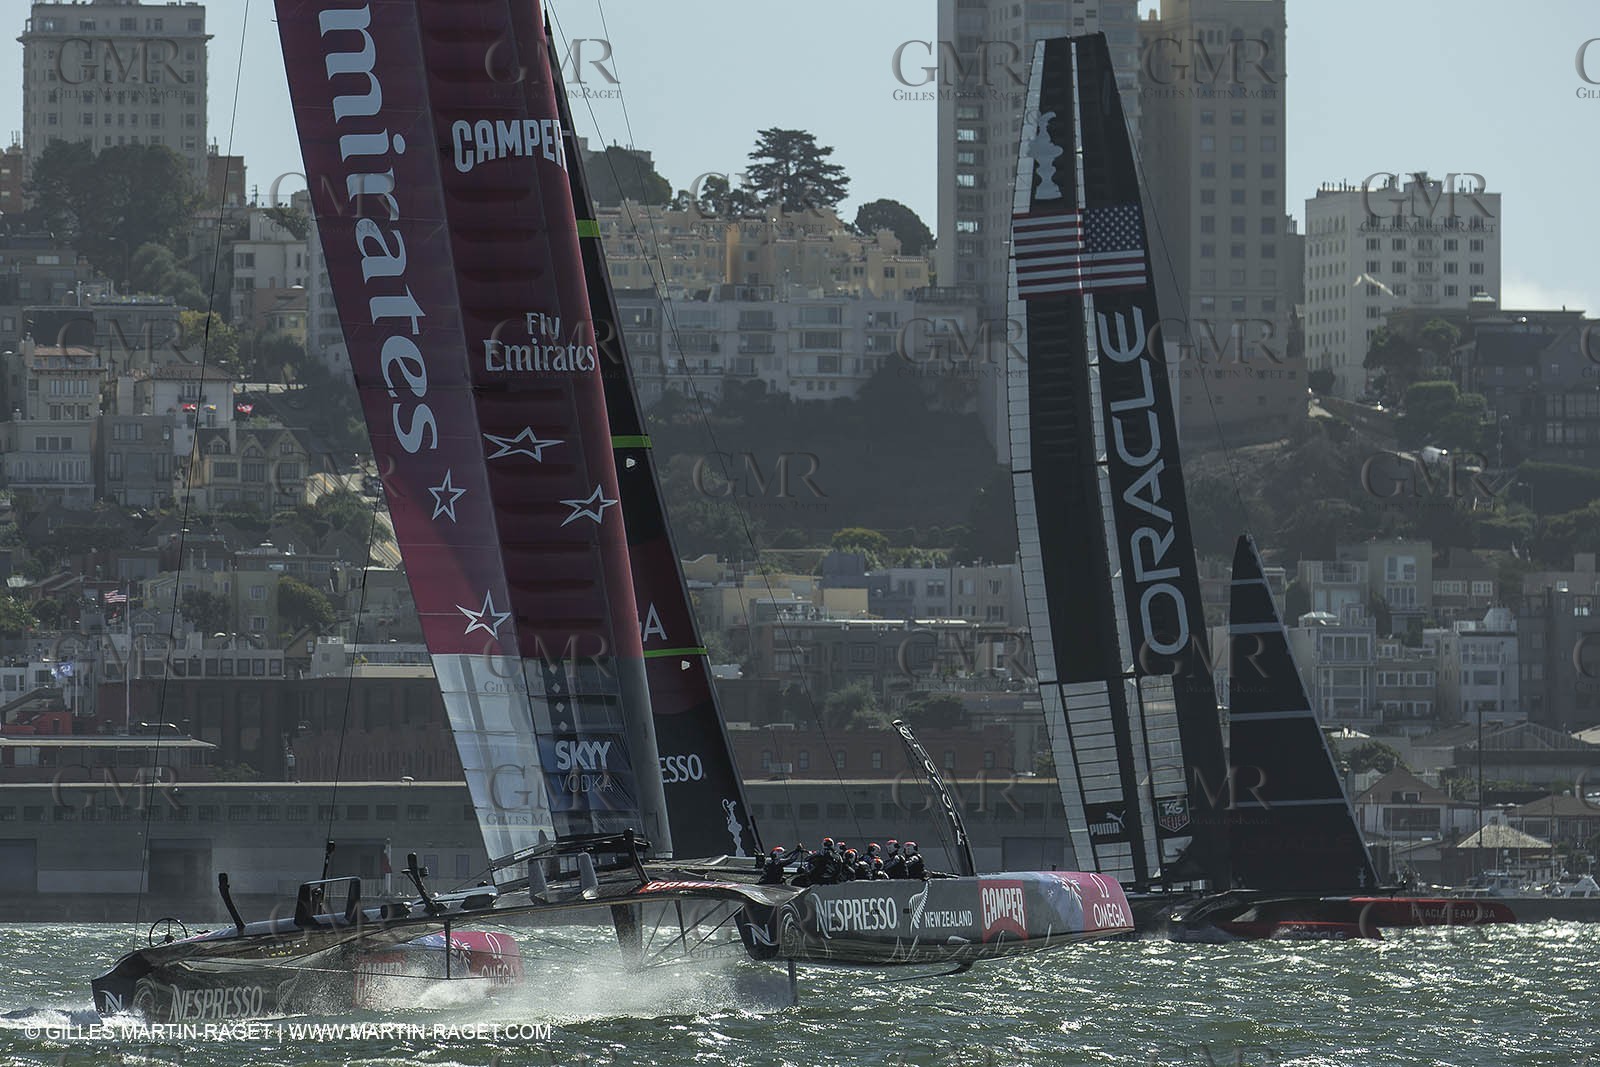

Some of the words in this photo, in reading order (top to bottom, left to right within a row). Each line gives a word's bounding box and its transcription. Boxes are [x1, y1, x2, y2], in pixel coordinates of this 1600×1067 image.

[526, 312, 560, 341] Fly
[483, 338, 595, 372] Emirates
[1097, 305, 1190, 655] ORACLE
[555, 740, 612, 770] SKYY
[557, 775, 615, 793] VODKA
[1162, 800, 1185, 815] TAG
[1089, 822, 1120, 837] PUMA
[1160, 815, 1188, 830] HEUER
[811, 892, 898, 939] NESPRESSO
[924, 911, 941, 928] NEW
[941, 911, 973, 928] ZEALAND
[982, 887, 1026, 930] CAMPER
[1093, 903, 1127, 928] OMEGA
[168, 983, 263, 1022] NESPRESSO
